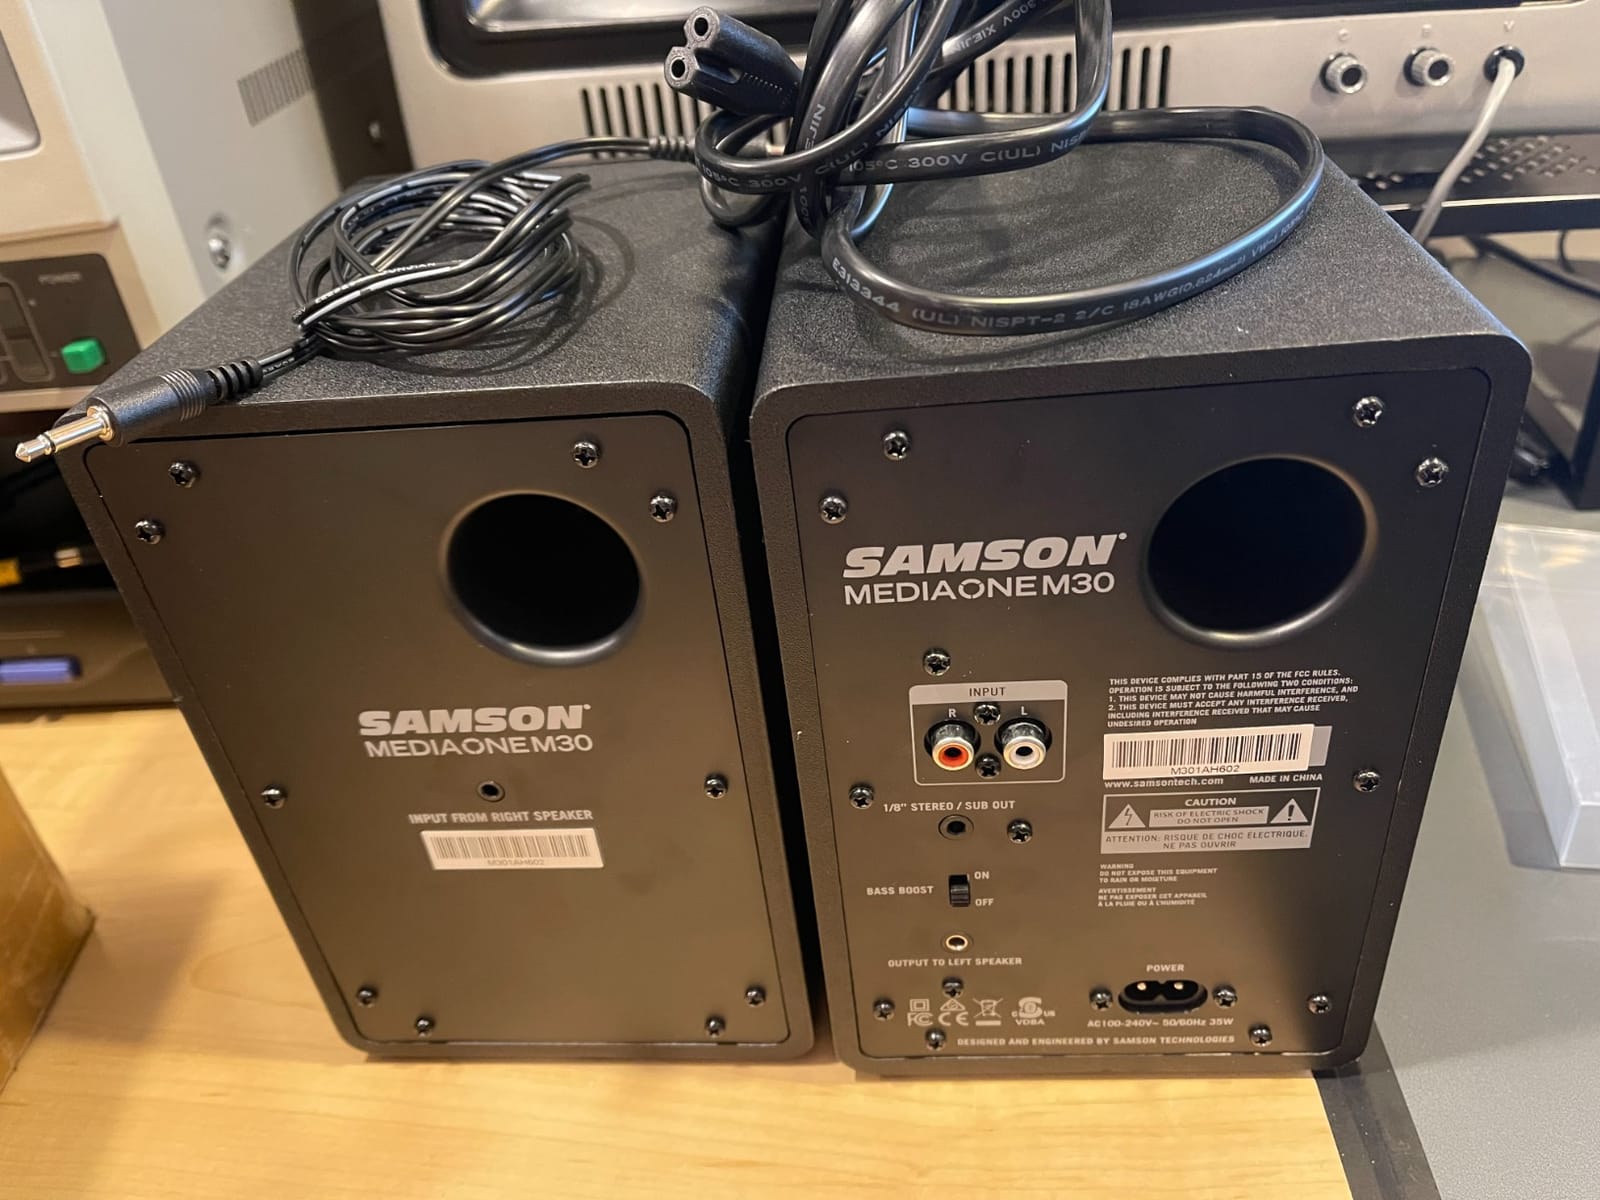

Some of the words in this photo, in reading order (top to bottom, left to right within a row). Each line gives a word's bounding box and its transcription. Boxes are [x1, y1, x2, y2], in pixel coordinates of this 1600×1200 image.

[907, 153, 969, 169] 300V
[979, 145, 1041, 163] C(UL)
[748, 173, 801, 188] 300V
[911, 307, 961, 326] (UL)
[970, 312, 1066, 328] NISPT-2
[1074, 304, 1116, 320] 2/C
[842, 533, 1119, 579] SAMSON
[843, 575, 1038, 605] MEDIAONE
[1042, 571, 1116, 596] M30
[1109, 678, 1128, 686] THIS
[1130, 677, 1159, 685] DEVICE
[1160, 675, 1202, 684] COMPLIES
[1204, 674, 1226, 682] WITH
[1294, 670, 1311, 678] FCC
[1312, 669, 1341, 677] RULES.
[1108, 686, 1153, 694] OPERATION
[1165, 684, 1201, 692] SUBJECT
[1215, 682, 1231, 690] THE
[1233, 680, 1279, 689] FOLLOWING
[1301, 677, 1354, 686] CONDITIONS:
[968, 687, 1007, 697] INPUT
[1139, 694, 1168, 702] DEVICE
[1189, 692, 1206, 700] NOT
[1208, 691, 1235, 699] CAUSE
[1236, 689, 1275, 697] HARMFUL
[1118, 703, 1137, 711] THIS
[1139, 702, 1168, 710] DEVICE
[1169, 701, 1193, 709] MUST
[1195, 700, 1226, 708] ACCEPT
[1227, 699, 1246, 707] ANY
[1246, 696, 1305, 705] INTERFERENCE
[1306, 695, 1349, 703] RECEIVED,
[948, 708, 957, 718] R
[1020, 706, 1028, 716] L
[1107, 711, 1150, 720] INCLUDING
[1152, 709, 1210, 718] INTERFERENCE
[1211, 707, 1250, 716] RECEIVED
[1252, 706, 1273, 714] THAT
[1274, 705, 1293, 713] MAY
[1293, 704, 1321, 712] CAUSE
[357, 704, 584, 736] SAMSON
[1107, 720, 1152, 728] UNDESIRED
[1153, 718, 1198, 727] OPERATION
[364, 736, 530, 758] MEDIAONE
[532, 734, 593, 753] M30
[1170, 765, 1240, 775] M301AH602
[1104, 777, 1224, 789] www.samsontech.com
[1249, 775, 1277, 784] MADE
[1292, 773, 1323, 782] CHINA
[910, 801, 954, 812] STEREO
[964, 800, 988, 810] SUB
[992, 800, 1016, 810] OUT
[1184, 797, 1237, 807] CAUTION
[407, 812, 448, 825] INPUT
[450, 812, 488, 824] FROM
[491, 810, 530, 822] RIGHT
[532, 809, 594, 821] SPEAKER
[1153, 810, 1175, 818] RISK
[1175, 810, 1187, 818] OF
[1189, 809, 1232, 817] ELECTRIC
[1233, 808, 1265, 816] SHOCK
[1163, 833, 1199, 841] RISQUE
[1202, 832, 1215, 841] DE
[1217, 831, 1245, 840] CHOC
[1178, 841, 1198, 849] PAS
[1200, 840, 1237, 849] OUVRIR
[974, 871, 990, 880] ON
[1175, 867, 1218, 875] EQUIPMENT
[866, 886, 896, 896] BASS
[898, 885, 934, 895] BOOST
[975, 898, 994, 907] OFF
[887, 958, 929, 968] OUTPUT
[932, 957, 946, 967] TO
[948, 957, 972, 967] LEFT
[974, 956, 1023, 966] SPEAKER
[1145, 963, 1185, 973] POWER
[1208, 1017, 1235, 1026] 35W
[957, 1037, 1005, 1046] DESIGNED
[1008, 1037, 1029, 1046] AND
[1031, 1036, 1094, 1046] ENGINEERED
[1096, 1037, 1110, 1045] BY
[1113, 1036, 1157, 1045] SAMSON
[1160, 1035, 1236, 1045] TECHNOLOGIES
